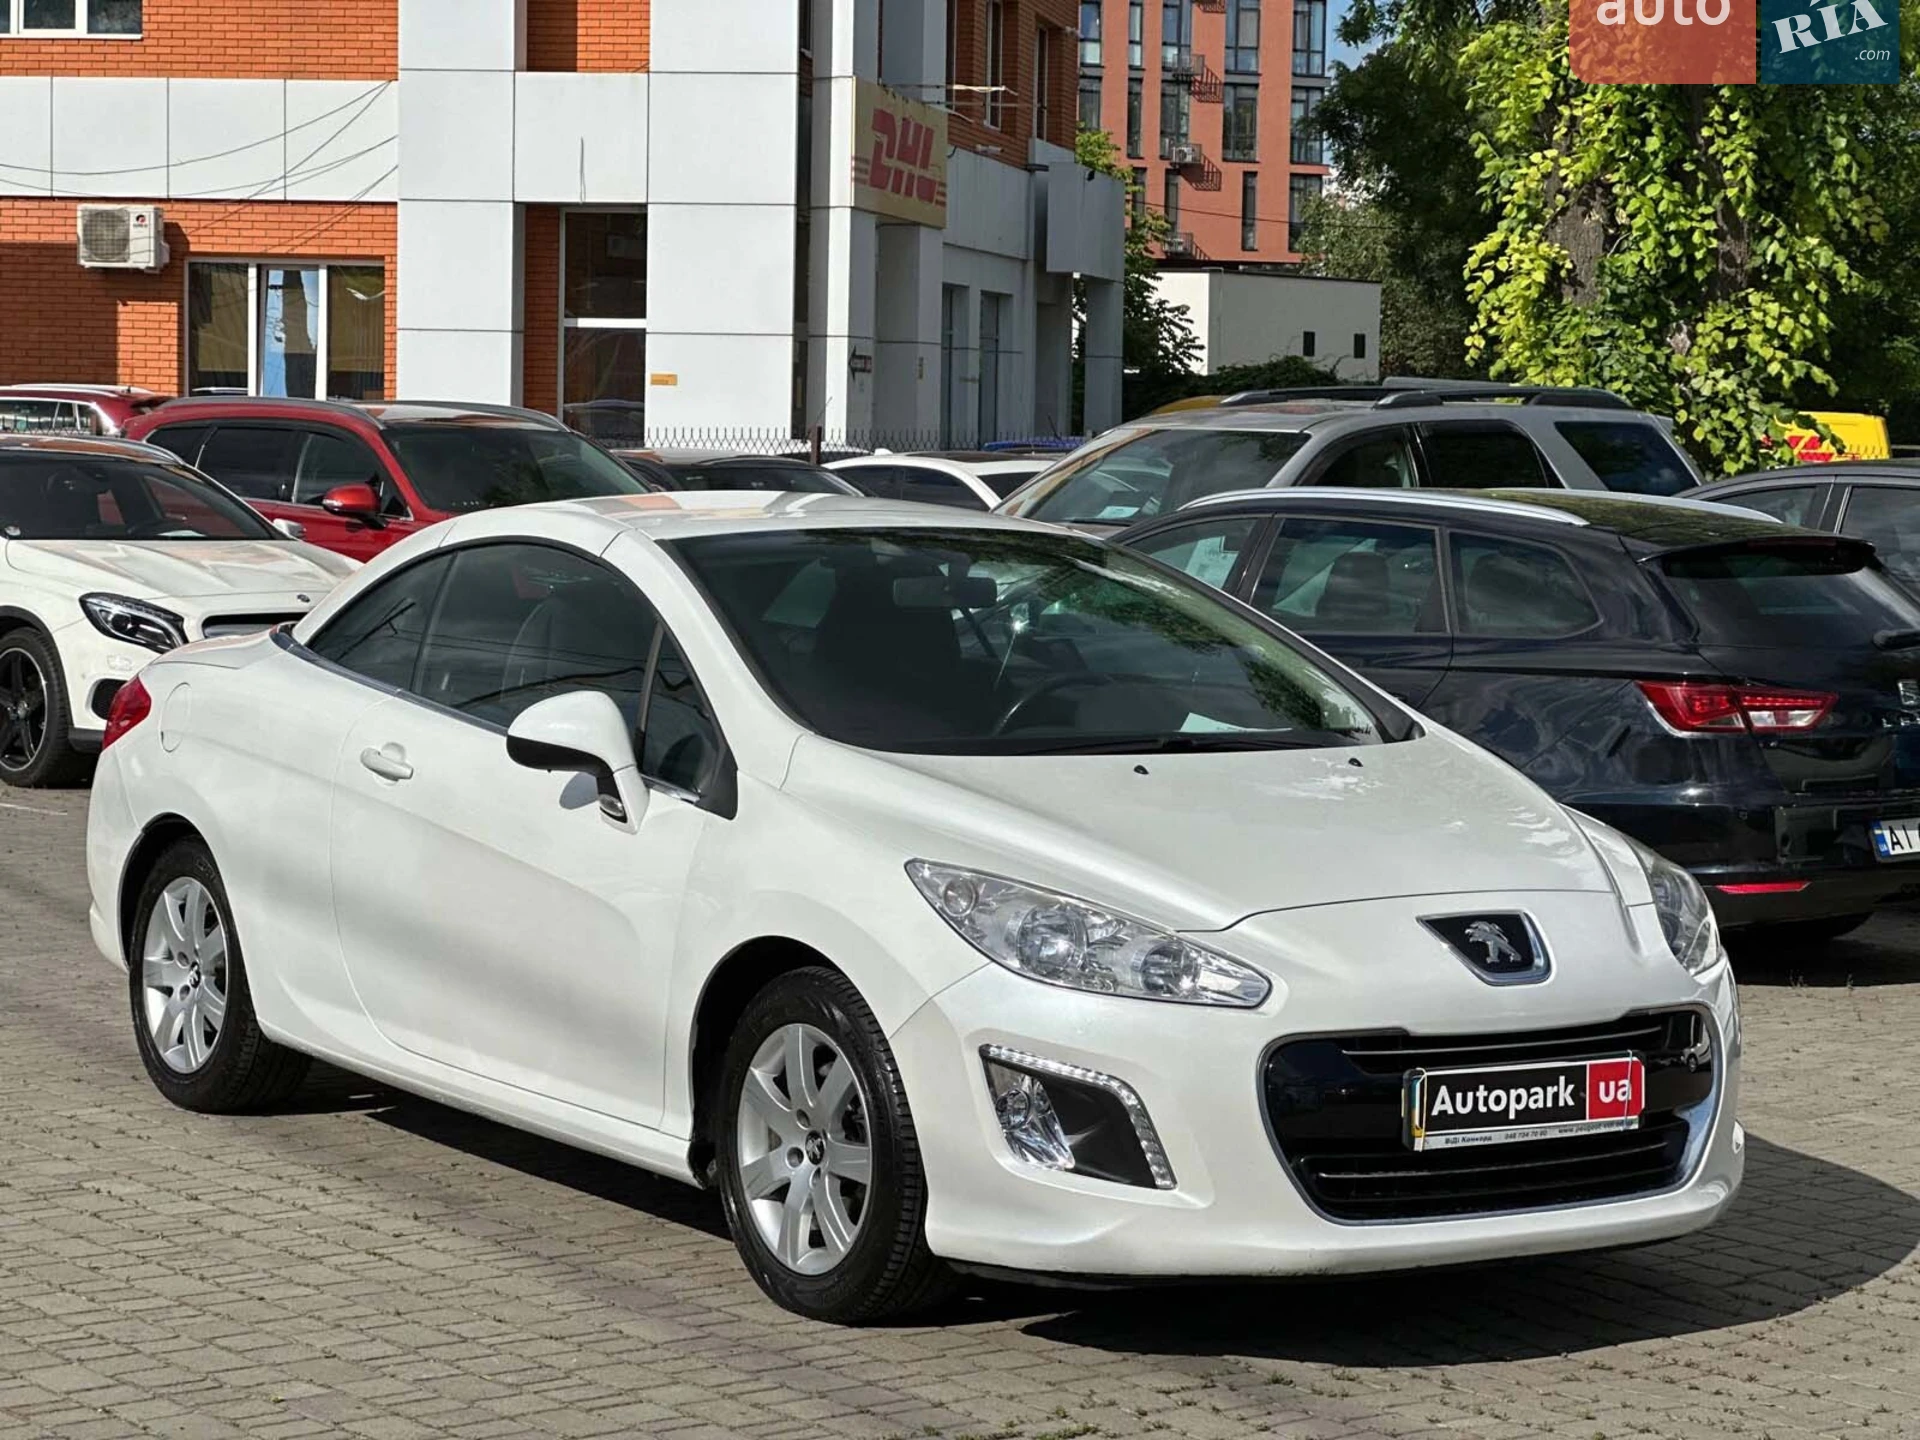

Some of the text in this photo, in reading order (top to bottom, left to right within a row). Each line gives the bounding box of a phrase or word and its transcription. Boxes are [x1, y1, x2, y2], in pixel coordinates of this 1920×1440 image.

[868, 108, 938, 205] DHL
[1430, 1075, 1633, 1120] Autopark ua
